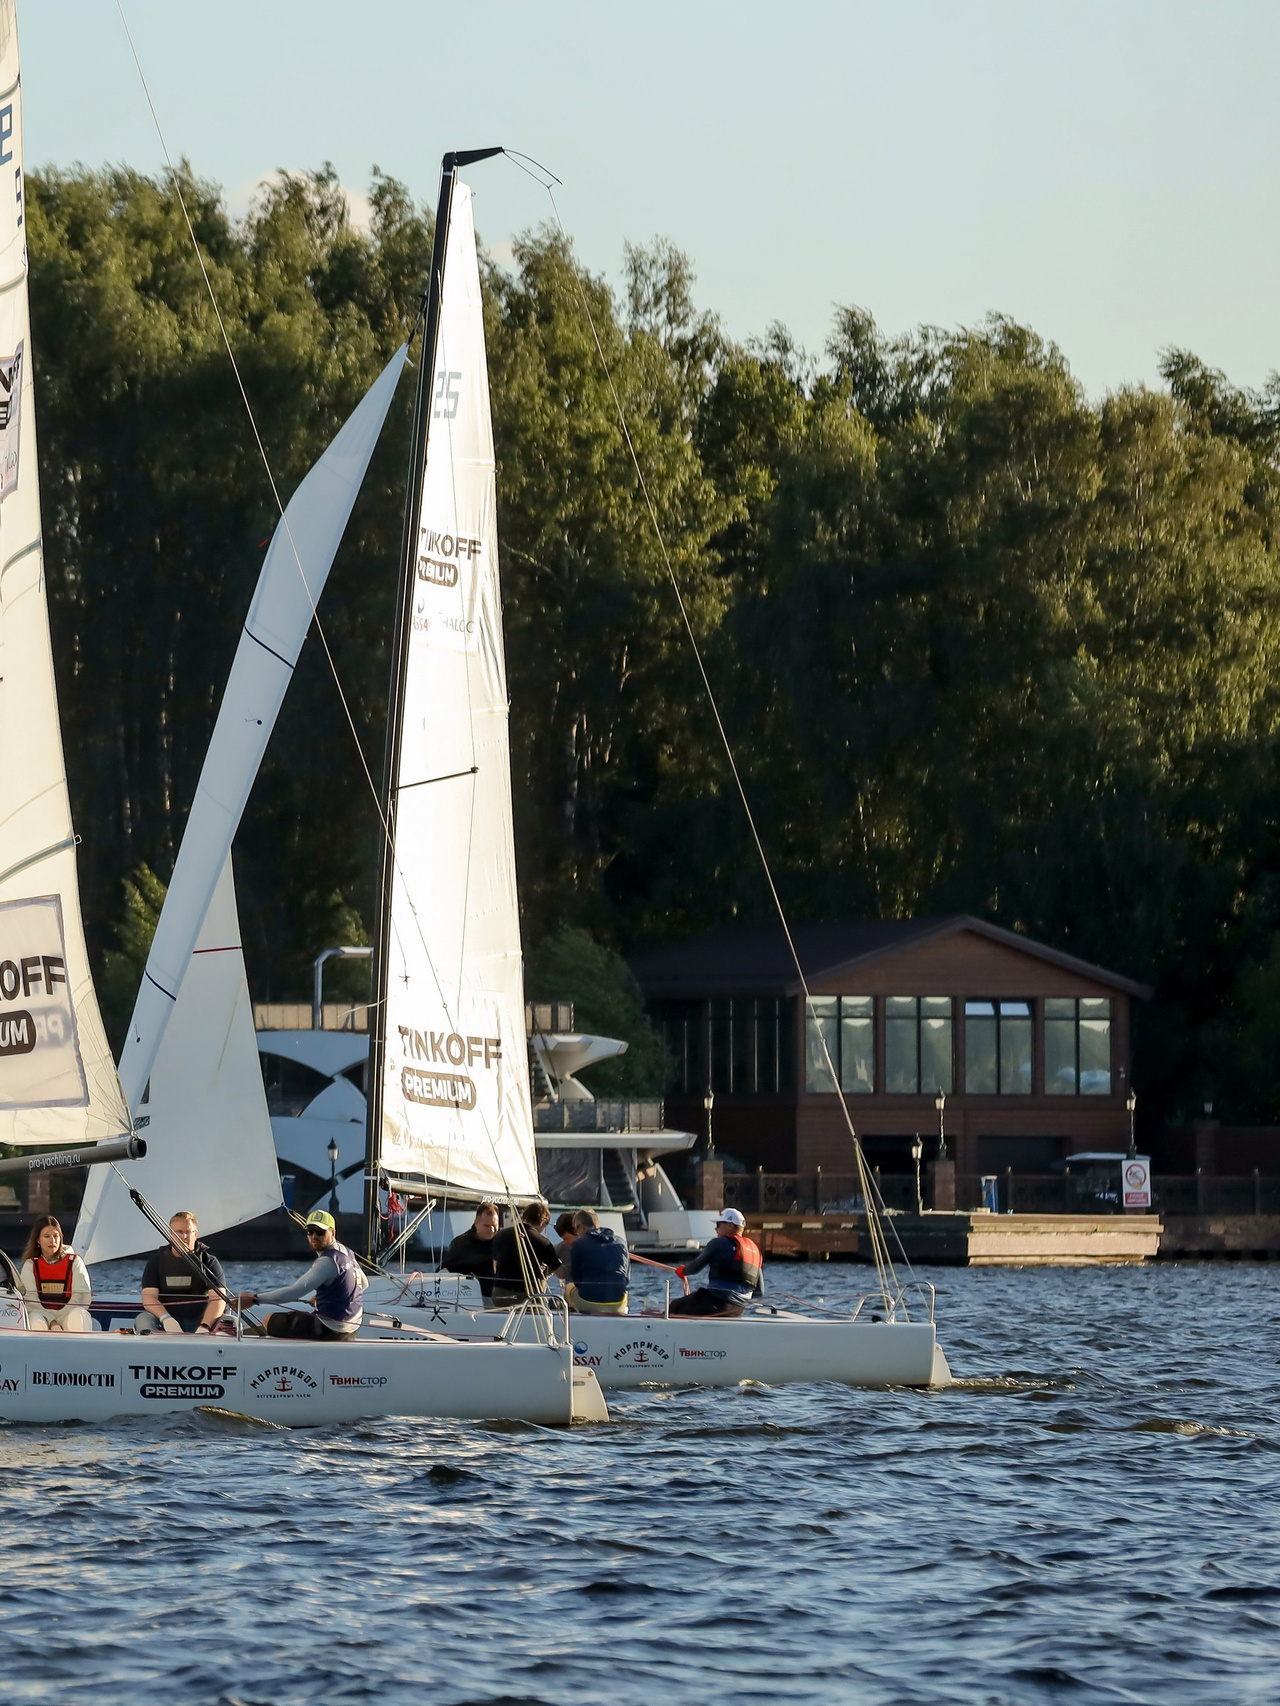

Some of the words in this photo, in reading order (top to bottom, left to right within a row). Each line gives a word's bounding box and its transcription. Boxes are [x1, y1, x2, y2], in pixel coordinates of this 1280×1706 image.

[434, 371, 462, 419] 25
[398, 1025, 503, 1069] TINKOFF
[404, 1074, 472, 1104] PREMIUM
[28, 1154, 81, 1171] pro-yachting.ru
[614, 1341, 670, 1361] МОРПРИБОР
[573, 1355, 603, 1366] SSAY
[32, 1371, 115, 1387] ВЕДОМОСТИ
[128, 1365, 238, 1380] TINKOFF
[250, 1366, 318, 1389] МОРПРИБОР
[145, 1386, 220, 1397] PREMIUM
